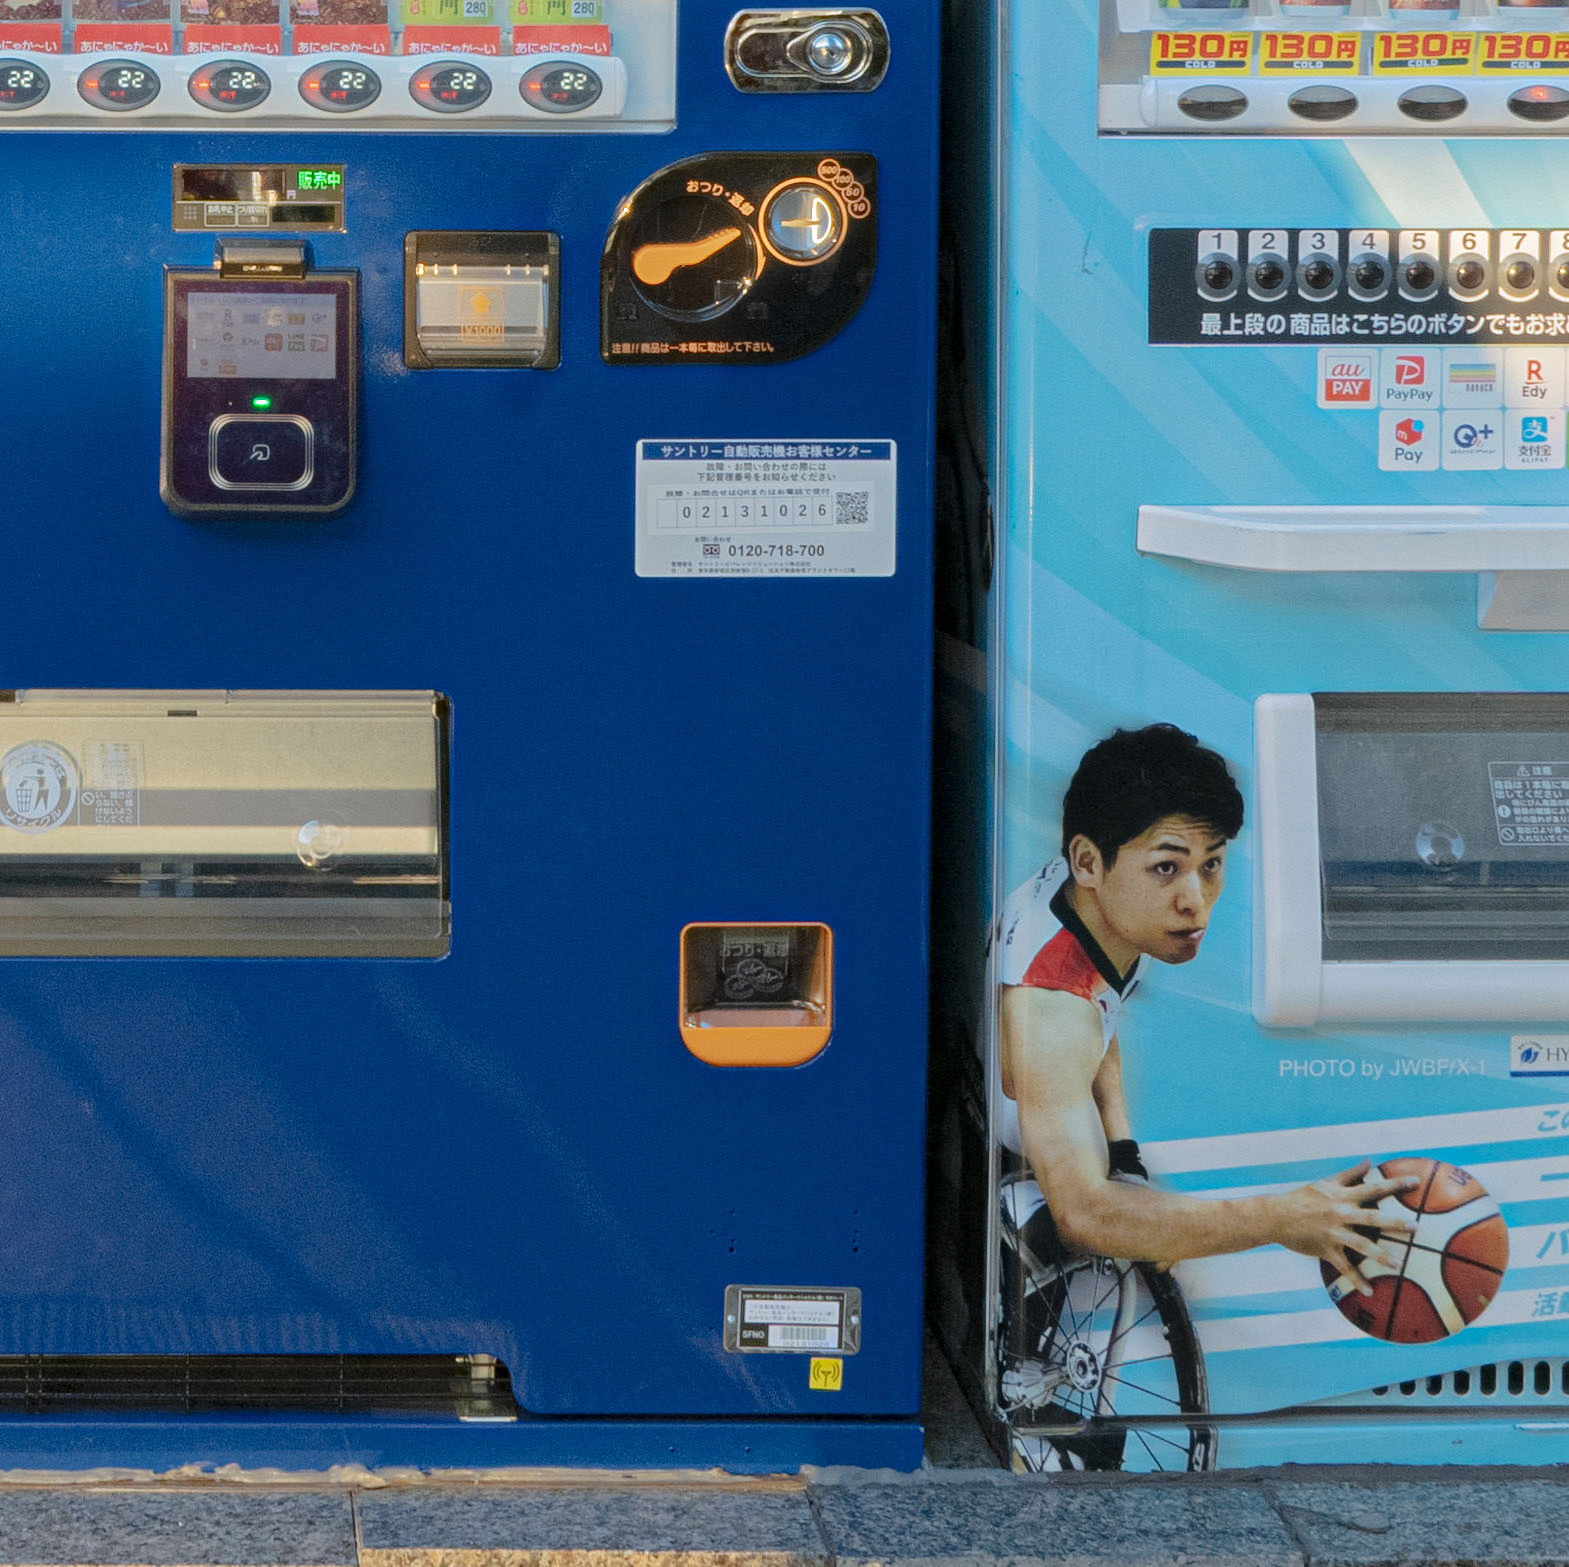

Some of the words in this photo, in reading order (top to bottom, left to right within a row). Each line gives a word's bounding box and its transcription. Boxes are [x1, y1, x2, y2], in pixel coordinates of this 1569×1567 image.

[465, 2, 486, 15] 280
[1157, 34, 1248, 59] 130円
[1380, 34, 1471, 59] 130円
[1185, 61, 1216, 69] COLD
[118, 70, 144, 86] 22
[451, 72, 476, 89] 22
[298, 171, 341, 189] 販売中
[853, 203, 865, 212] 10
[1213, 233, 1223, 250] 1
[1262, 233, 1277, 250] 2
[1312, 233, 1327, 250] 3
[1361, 233, 1377, 250] 4
[1412, 233, 1427, 250] 5
[1462, 233, 1477, 250] 6
[1512, 233, 1528, 250] 7
[1331, 362, 1366, 378] au
[1527, 360, 1543, 381] R
[1332, 382, 1364, 396] PAY
[1386, 388, 1434, 402] PayPay
[1522, 386, 1548, 401] Edy
[661, 445, 872, 458] サントリー自動販売機お客様センター
[1395, 447, 1423, 463] Pay
[1518, 444, 1552, 458] 支付宝
[728, 545, 825, 558] 0120-718-700
[1279, 1059, 1356, 1078] PHOTO
[1361, 1058, 1385, 1080] by
[1389, 1059, 1486, 1078] JWBF/X-1
